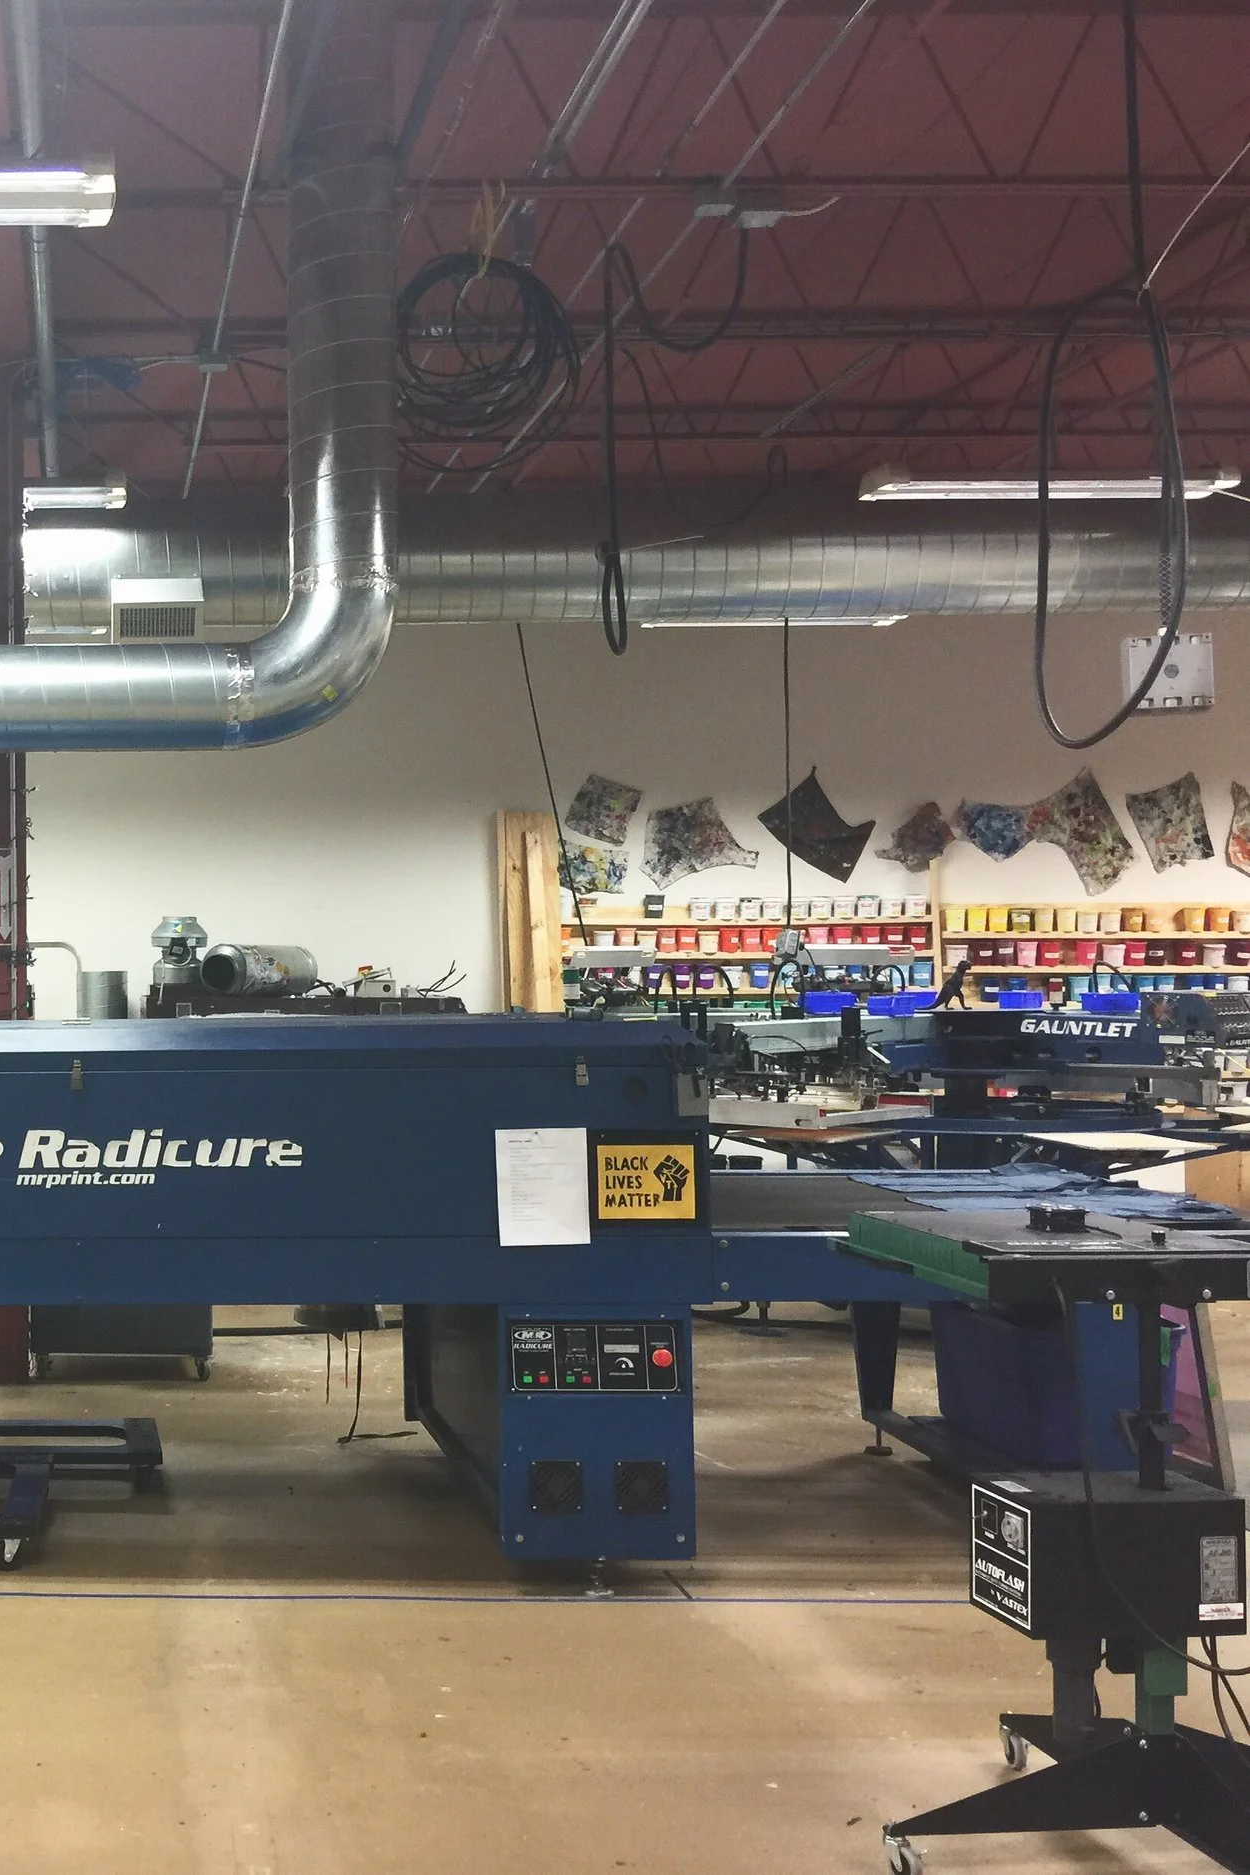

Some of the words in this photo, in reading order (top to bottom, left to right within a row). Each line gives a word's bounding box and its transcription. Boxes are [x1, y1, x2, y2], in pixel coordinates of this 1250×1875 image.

[1020, 1018, 1137, 1038] GAUNTLET
[18, 1128, 303, 1169] Radicure
[604, 1156, 649, 1171] BLACK
[16, 1170, 155, 1188] mrprint.com
[605, 1175, 643, 1190] LIVES
[659, 1173, 672, 1190] VT
[604, 1193, 661, 1208] MATTER
[975, 1558, 1025, 1593] AUTOFLASH
[996, 1591, 1028, 1616] VASTEX
